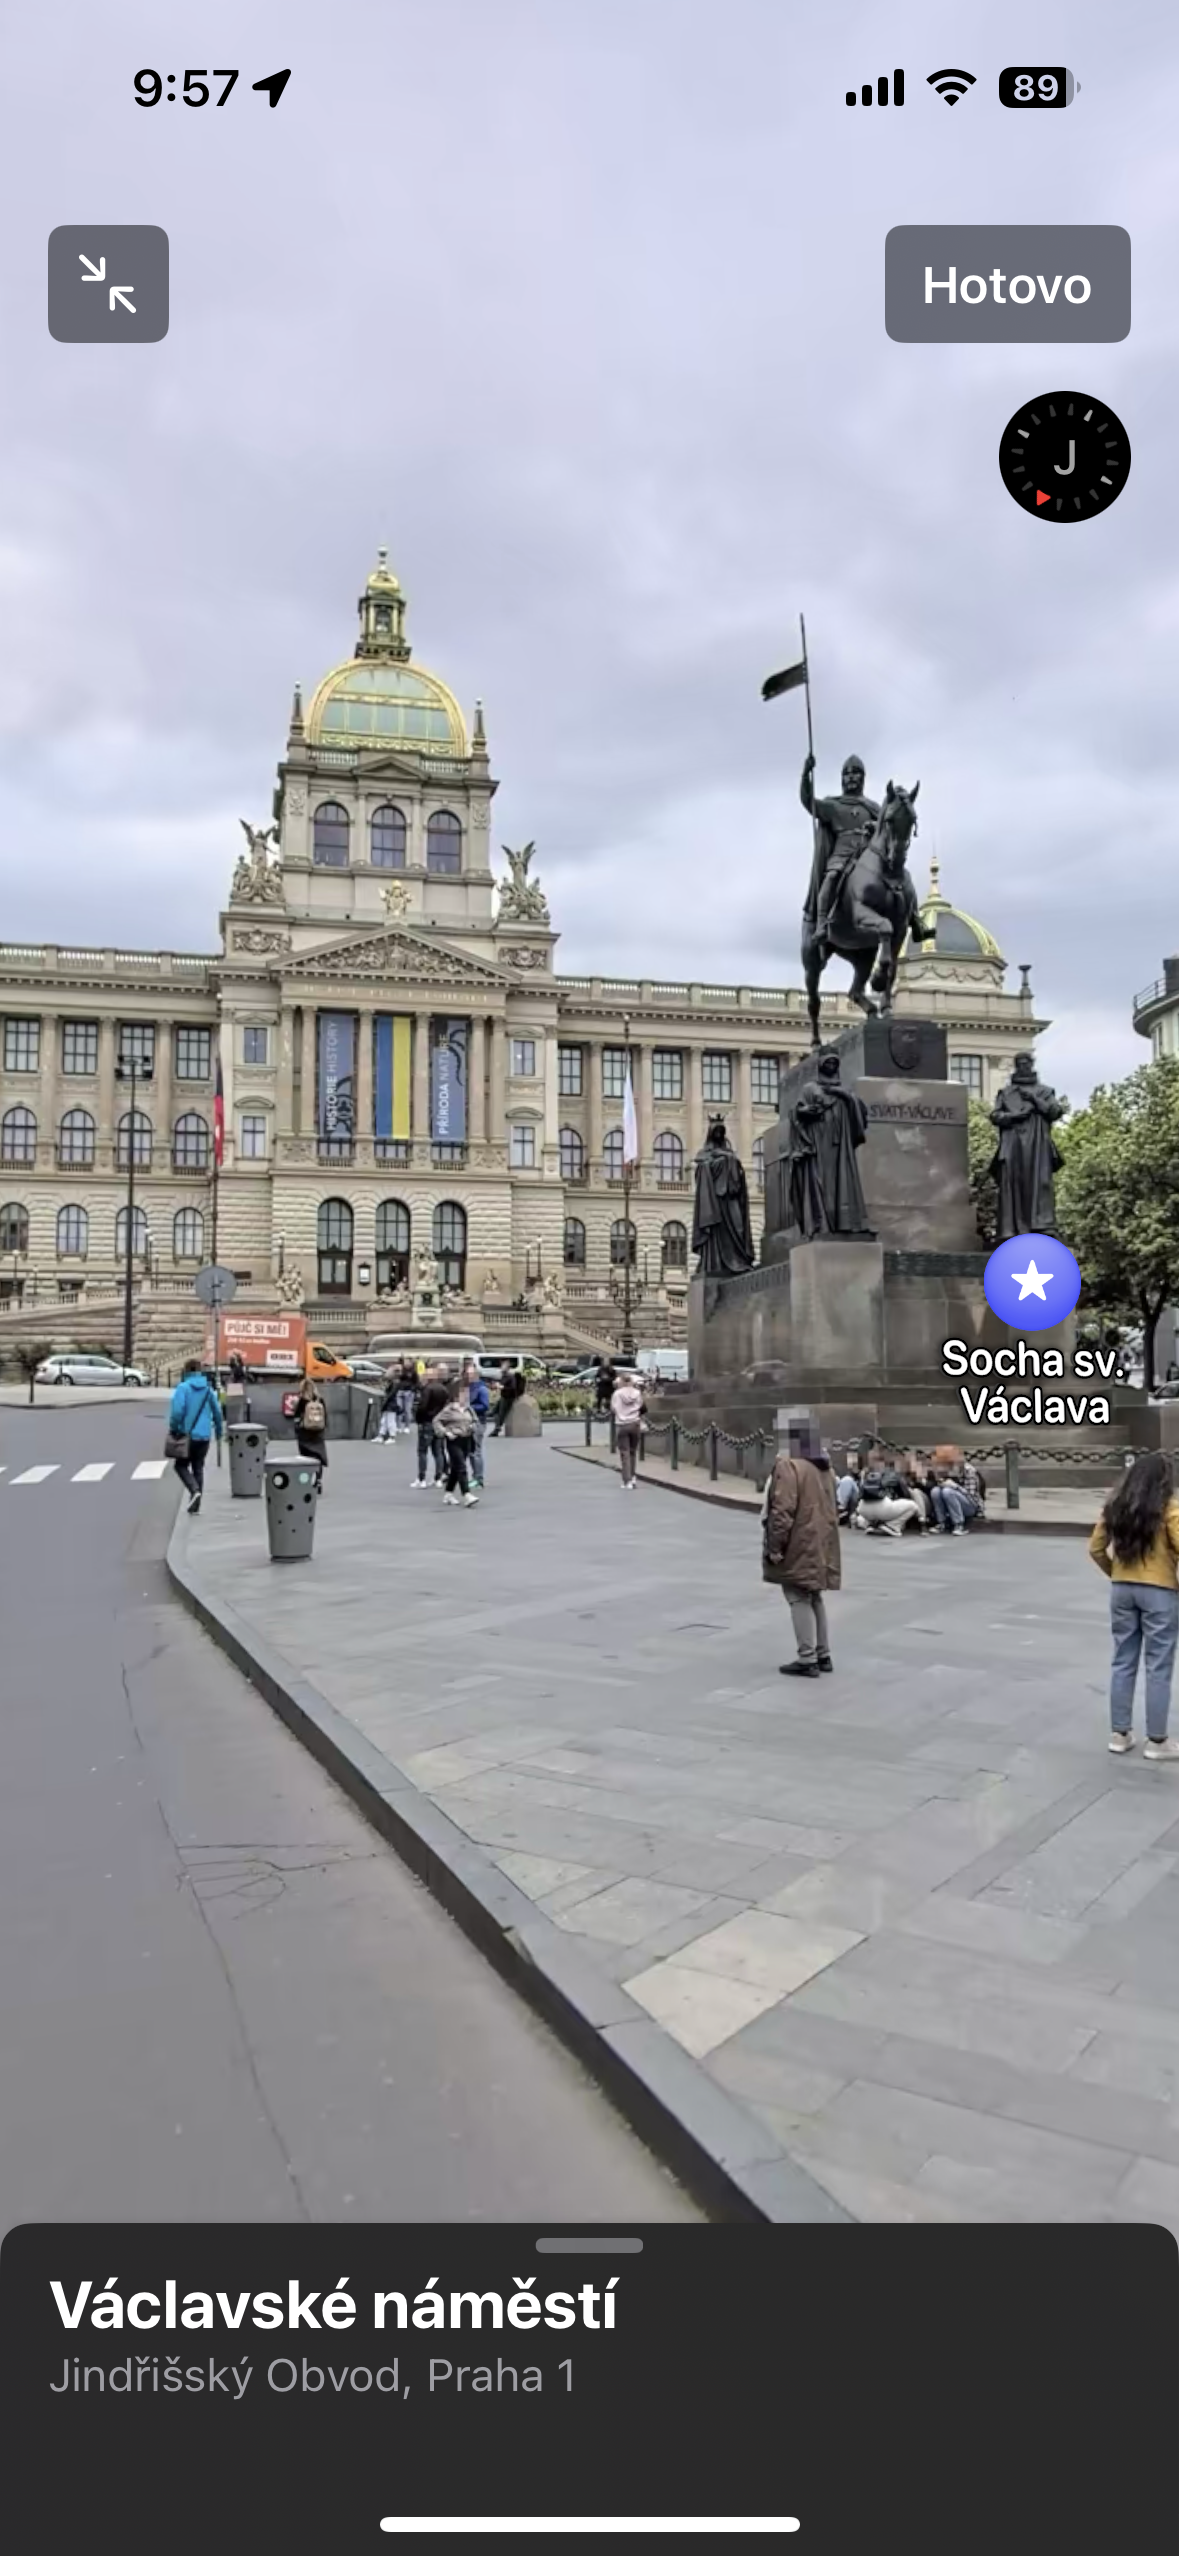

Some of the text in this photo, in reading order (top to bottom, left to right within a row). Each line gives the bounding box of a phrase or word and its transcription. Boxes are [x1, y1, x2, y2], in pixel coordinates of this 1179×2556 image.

[326, 1021, 338, 1131] HISTORIE HISTORY
[436, 1033, 449, 1135] PŘÍRODA NATURE
[254, 1323, 264, 1335] SI
